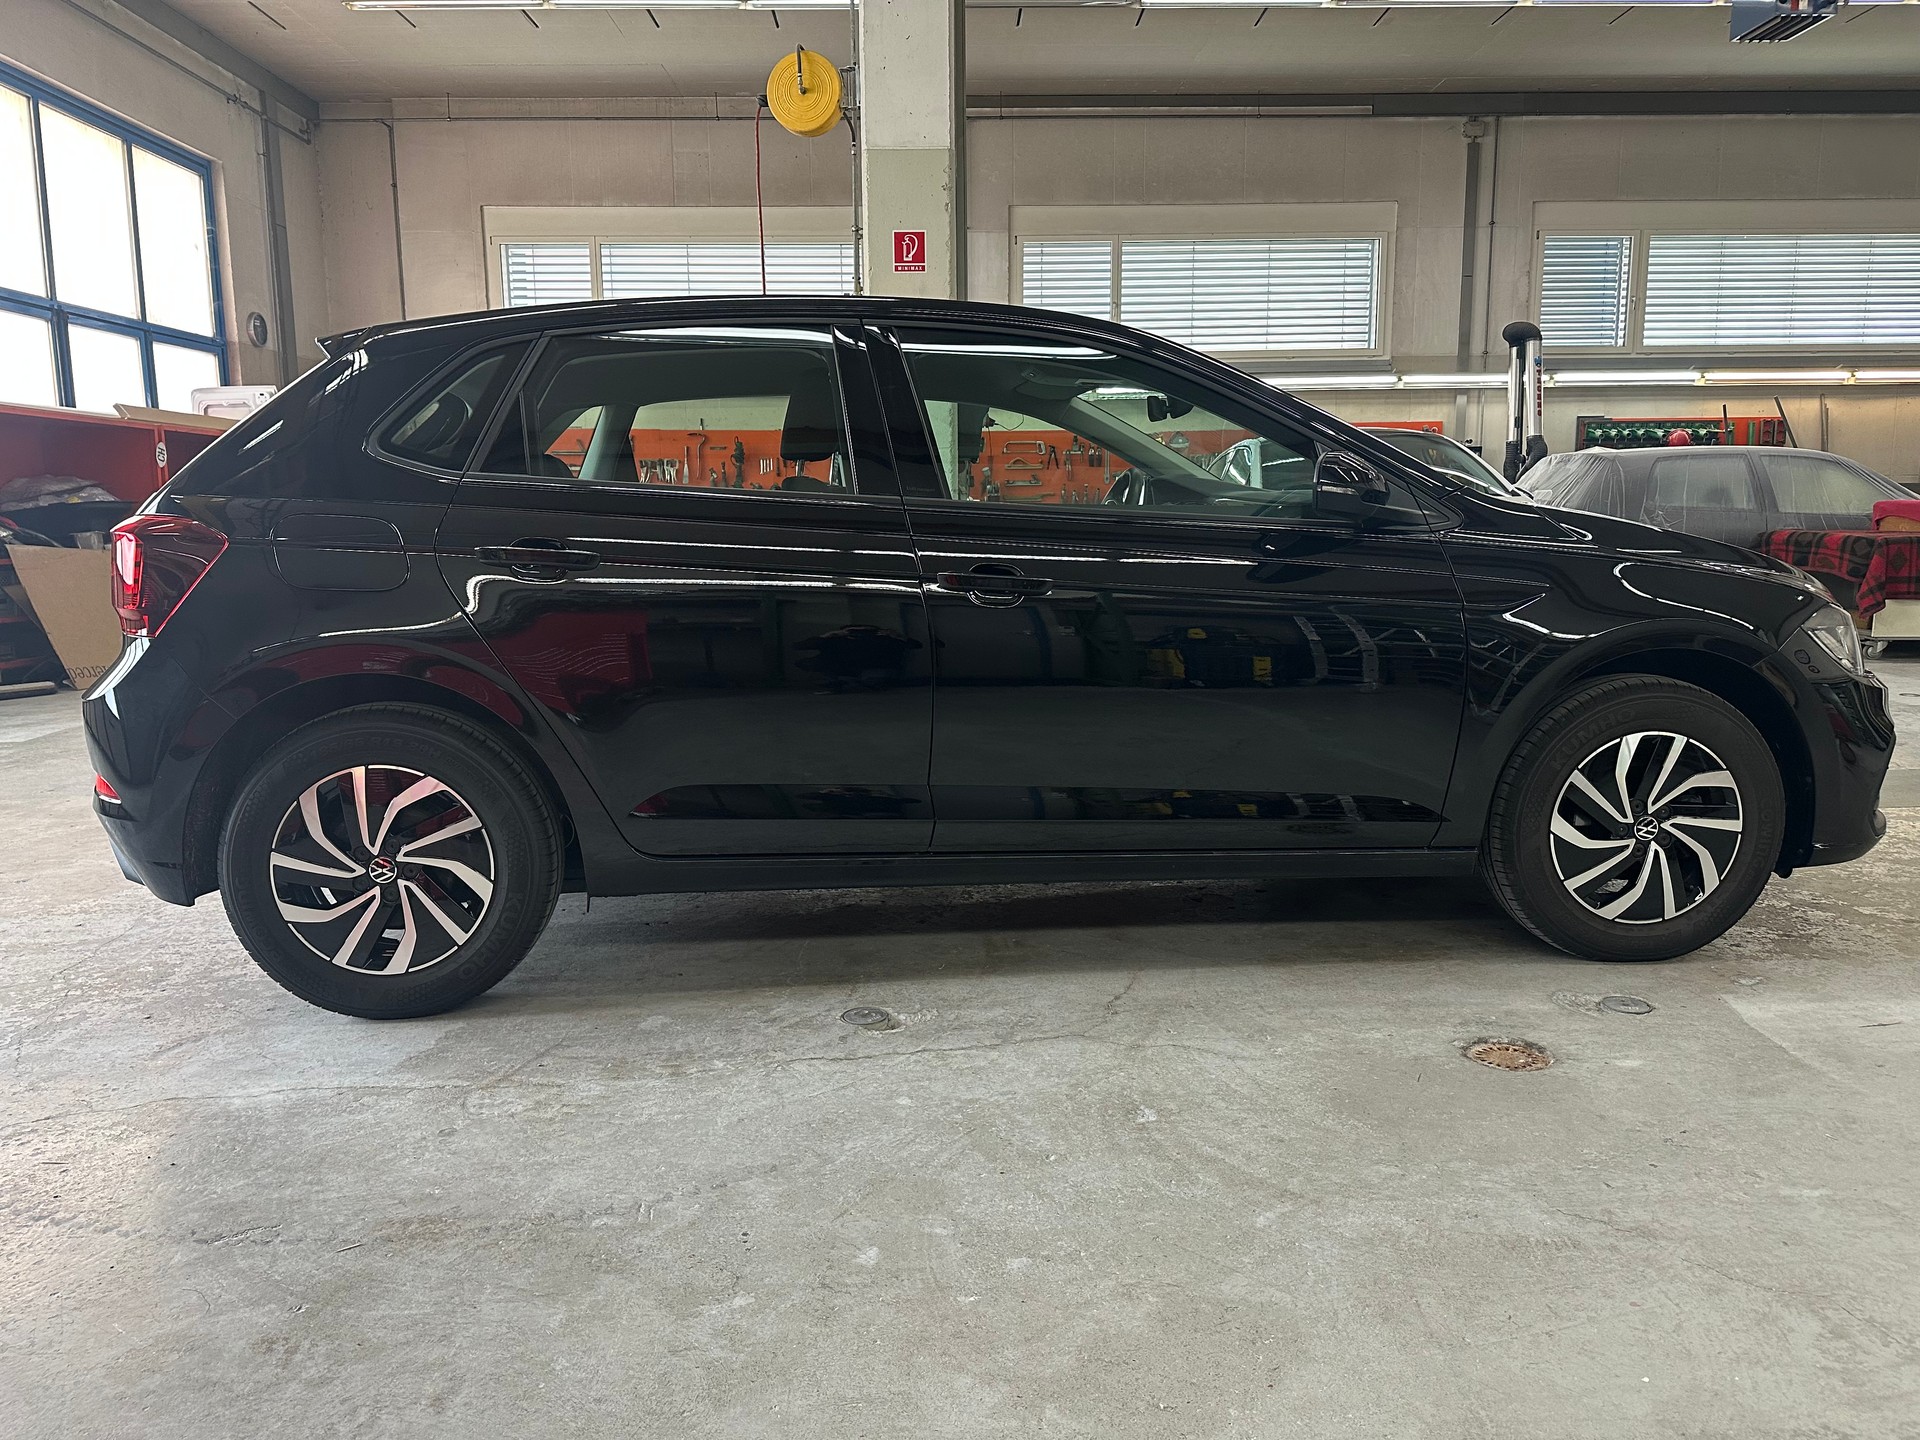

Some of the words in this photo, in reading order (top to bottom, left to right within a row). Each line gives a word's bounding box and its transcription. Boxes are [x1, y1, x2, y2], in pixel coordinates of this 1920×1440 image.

[157, 446, 166, 463] CH
[1549, 708, 1636, 770] KUMHO
[457, 892, 525, 981] KUMHO
